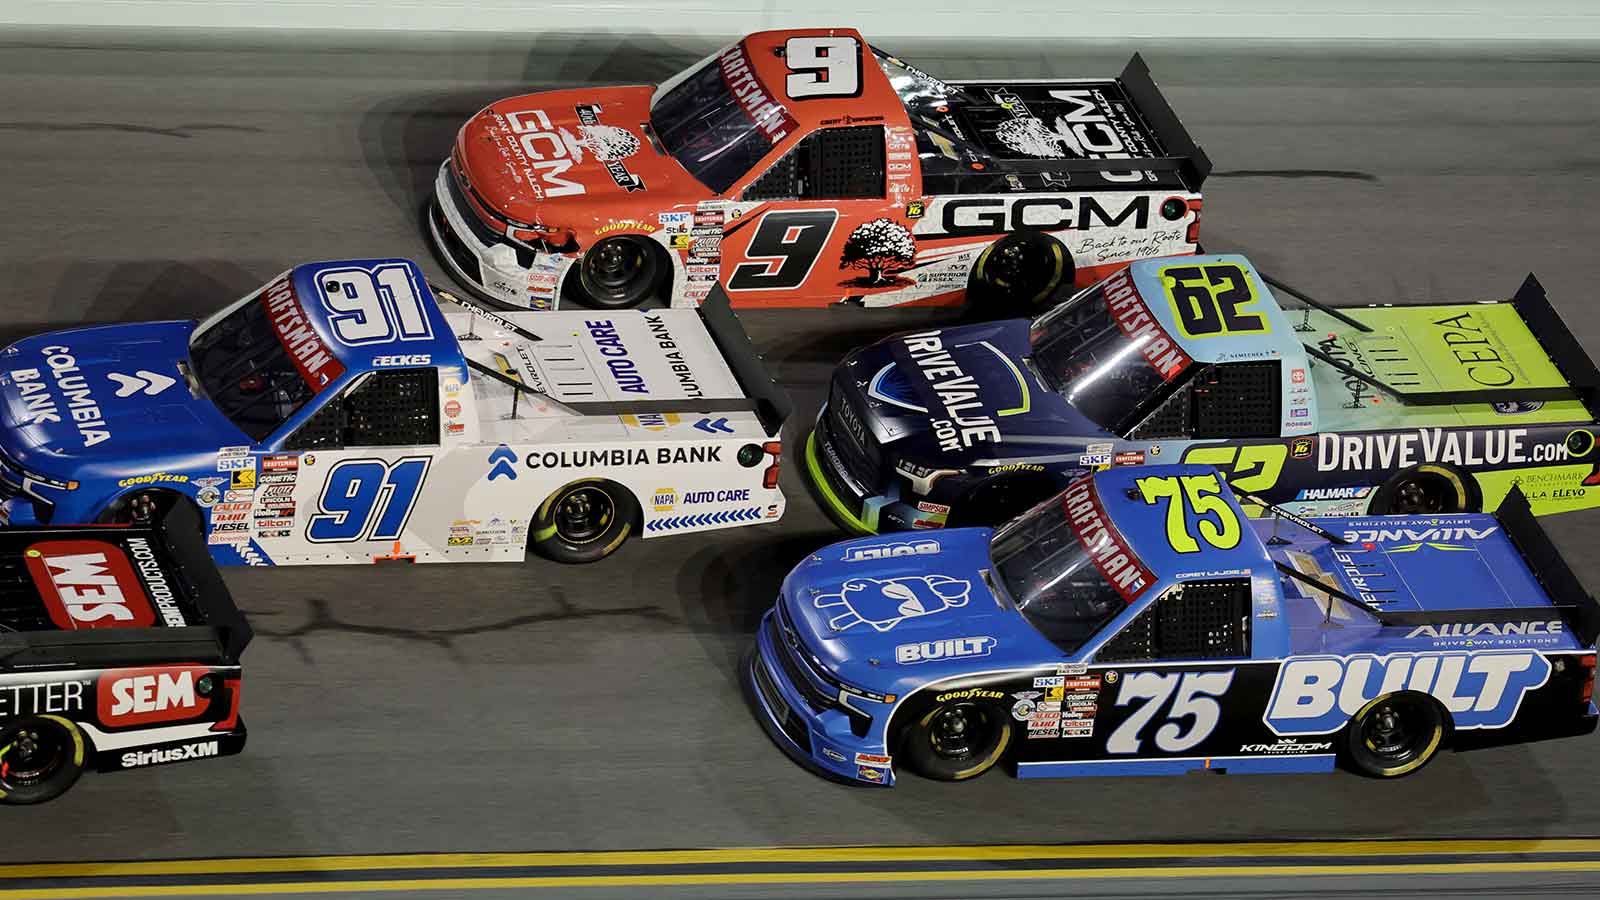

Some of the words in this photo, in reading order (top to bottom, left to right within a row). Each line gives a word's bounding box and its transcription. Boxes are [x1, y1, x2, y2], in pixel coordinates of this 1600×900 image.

[786, 36, 862, 100] 9
[505, 109, 587, 198] GCM
[607, 161, 630, 183] YEAR
[593, 221, 656, 236] GOODYEAR
[660, 213, 688, 223] SKF
[942, 196, 1150, 232] GCM
[727, 208, 839, 292] 9
[1076, 236, 1116, 254] Back
[1152, 230, 1182, 246] Roots
[1097, 246, 1132, 262] Since
[314, 263, 435, 347] 91
[1162, 264, 1267, 337] 62
[460, 300, 519, 332] CHEVROLET
[585, 319, 628, 357] CARE
[644, 315, 677, 350] BANK
[1432, 311, 1516, 387] CEPA
[516, 344, 548, 395] EVROLET
[606, 358, 649, 394] AUTO
[665, 351, 704, 399] LUMBIA
[10, 367, 61, 425] BANK
[41, 345, 111, 448] COLUMBIA
[219, 457, 255, 470] SKF
[525, 448, 650, 470] COLUMBIA
[657, 445, 722, 465] BANK
[1080, 455, 1110, 465] SKF
[1317, 427, 1568, 473] DRIVEVALUE.COM
[118, 471, 190, 488] GOODYEAR
[260, 474, 296, 483] COMETIC
[988, 461, 1046, 475] GOODYEAR
[304, 454, 433, 545] 91
[653, 493, 675, 505] NAPA
[683, 489, 715, 504] AUTO
[717, 488, 750, 501] CARE
[919, 502, 948, 513] SIMPSON
[1303, 487, 1354, 500] HALMAR
[1552, 489, 1586, 498] ELEVO
[214, 522, 250, 531] JESEL
[1136, 473, 1241, 554] 75
[1270, 505, 1324, 535] CHEVROLET
[1065, 482, 1142, 590] CRAFTSMAN
[43, 552, 135, 622] SEM
[1405, 620, 1563, 639] ALLIANCE
[897, 637, 994, 663] BUILT
[111, 671, 196, 716] SEM
[935, 688, 1004, 703] GOODYEAR
[1035, 678, 1064, 687] SKF
[1265, 651, 1542, 730] BUILT
[1104, 668, 1237, 755] 75
[1031, 728, 1060, 736] JESEL
[1240, 742, 1333, 752] KINGDOM
[120, 740, 219, 768] SiriusXM
